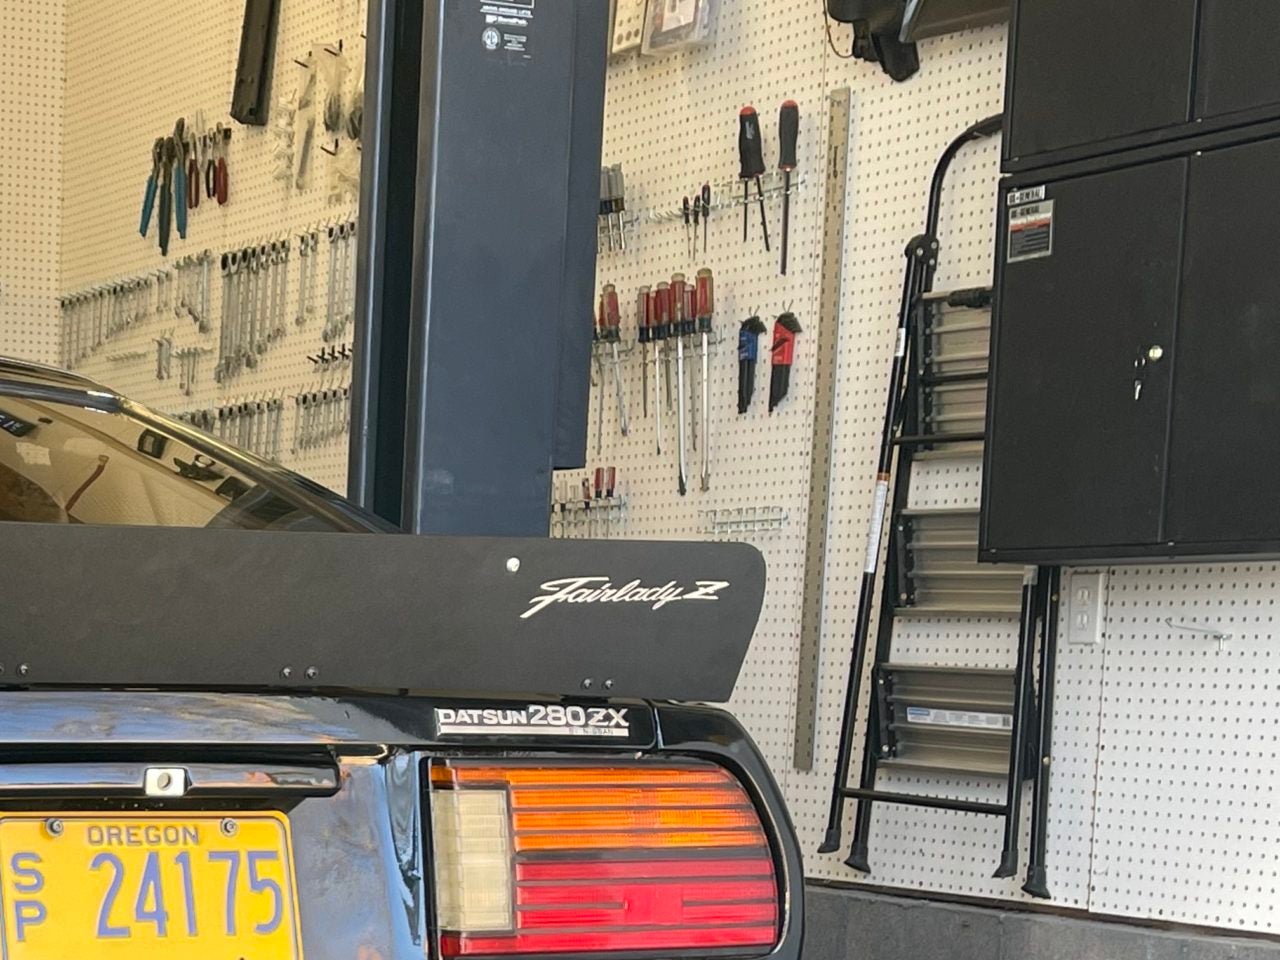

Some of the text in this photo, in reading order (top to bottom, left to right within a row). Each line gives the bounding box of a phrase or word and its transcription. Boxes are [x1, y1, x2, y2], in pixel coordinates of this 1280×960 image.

[519, 576, 730, 619] Fairlady Z
[439, 708, 527, 725] DATSUN
[87, 824, 200, 847] OREGON
[89, 850, 284, 939] 24175
